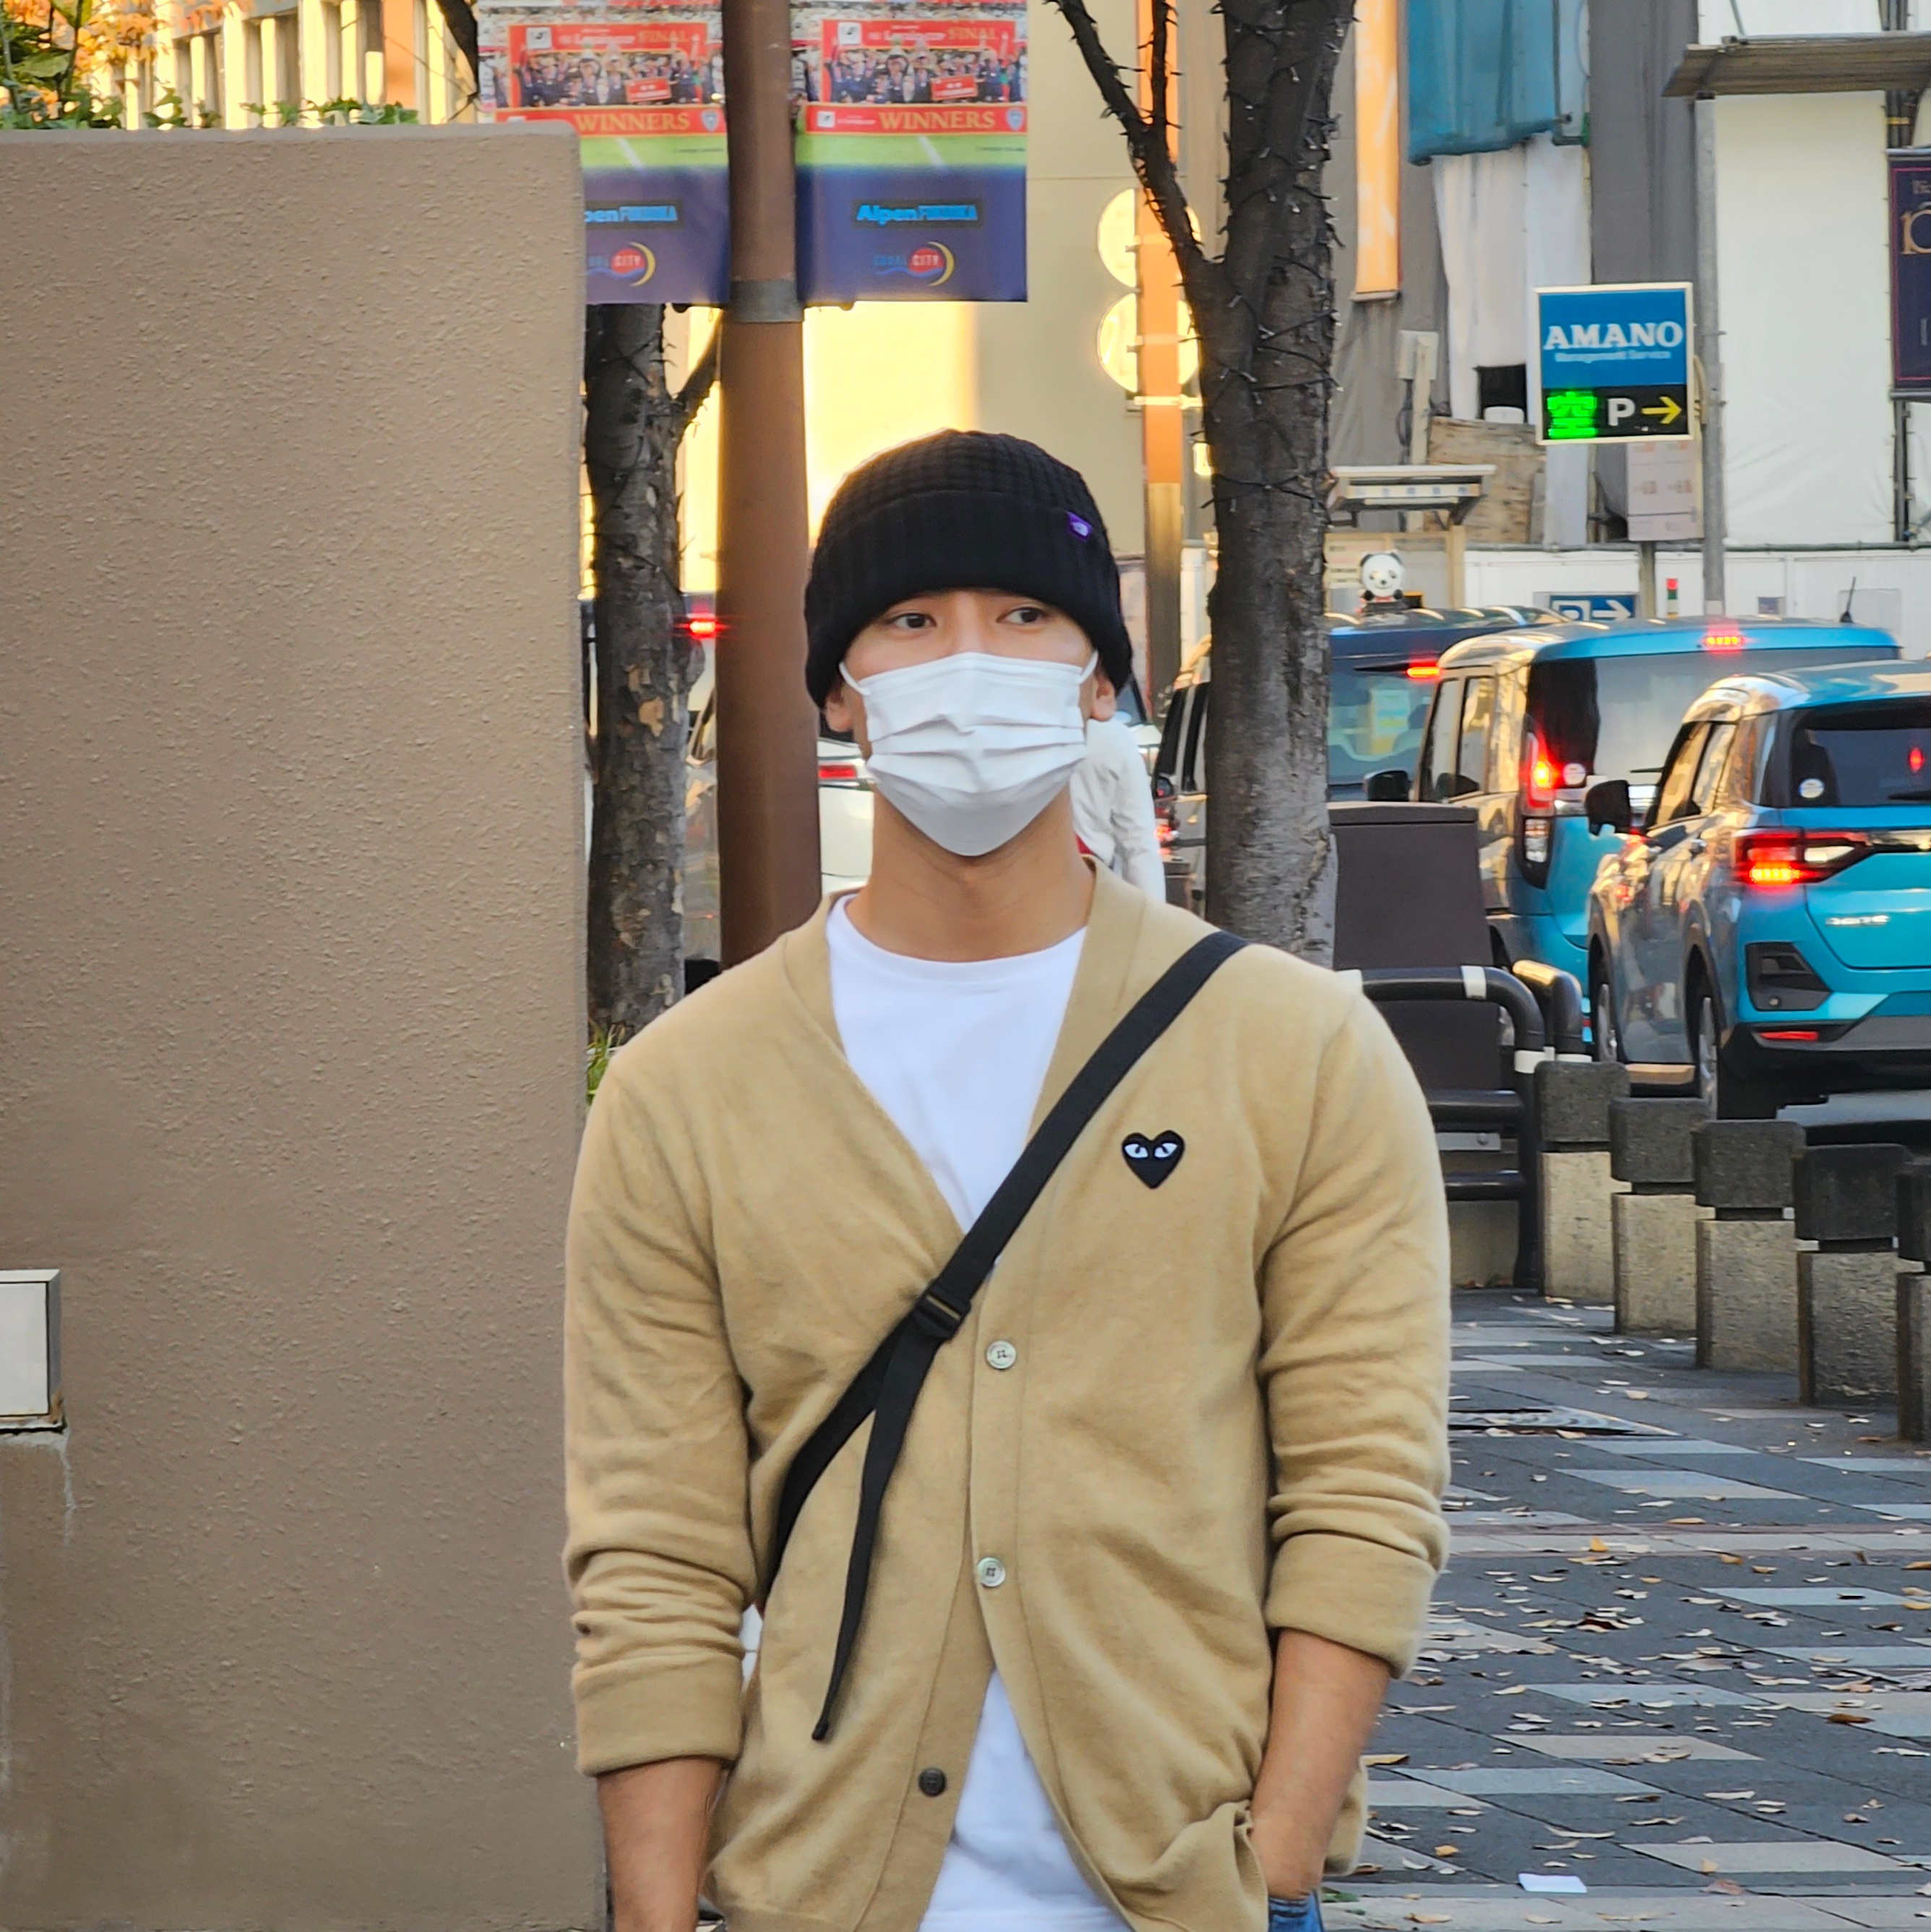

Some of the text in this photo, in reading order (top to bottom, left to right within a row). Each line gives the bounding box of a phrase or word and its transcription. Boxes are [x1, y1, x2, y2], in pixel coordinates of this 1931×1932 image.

[574, 112, 690, 131] WINNERS
[878, 111, 996, 129] WINNERS
[911, 254, 939, 266] CITY
[1543, 321, 1683, 350] AMANO
[1547, 391, 1597, 439] 空
[1608, 398, 1635, 426] P
